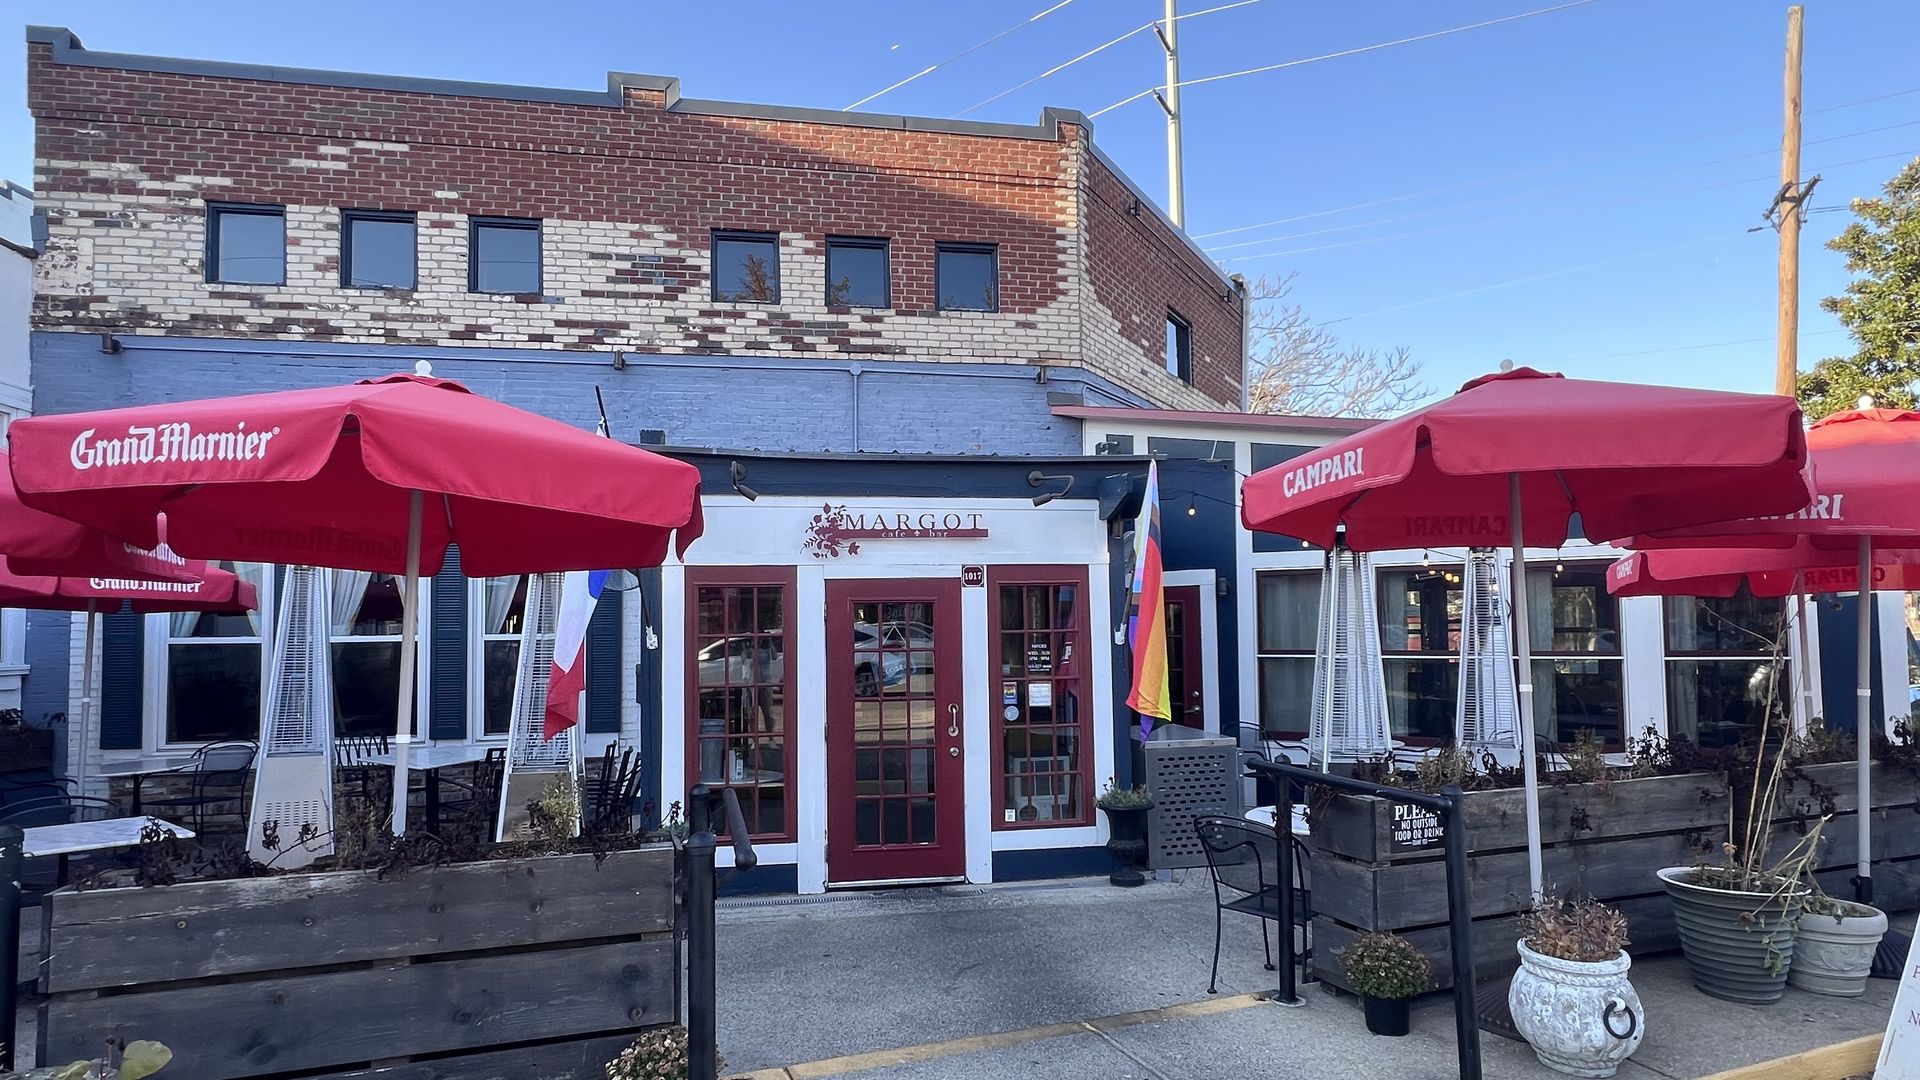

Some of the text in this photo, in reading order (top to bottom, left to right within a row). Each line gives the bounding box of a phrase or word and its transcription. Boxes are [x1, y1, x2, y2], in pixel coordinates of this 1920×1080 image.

[70, 425, 154, 470] Grand
[1283, 447, 1364, 498] CAMPARI
[845, 513, 983, 530] MARGOT
[965, 572, 982, 581] 1017
[1401, 816, 1438, 830] NO OUTSIDE
[1395, 827, 1444, 841] FOOD OR DRINK
